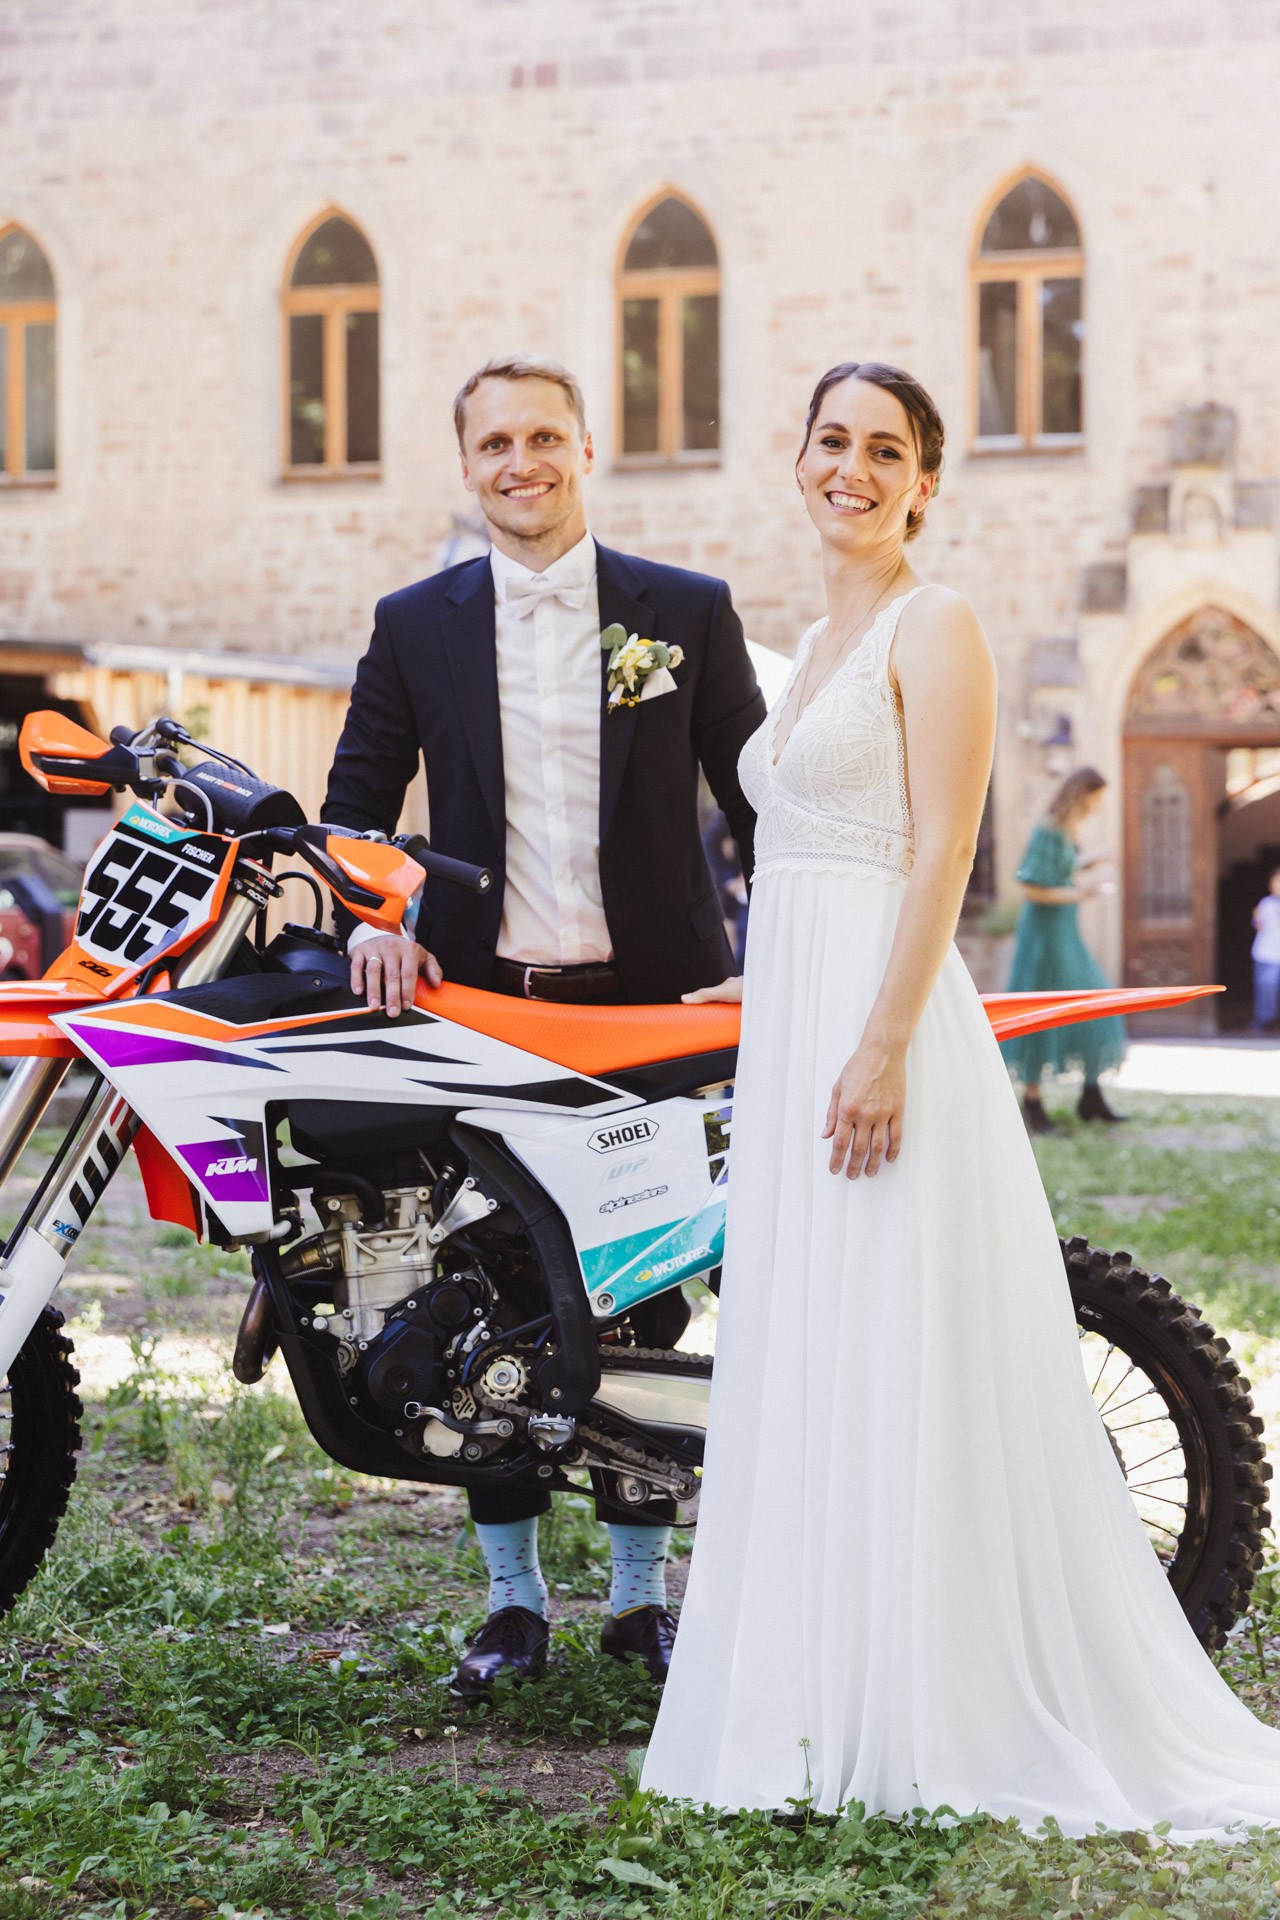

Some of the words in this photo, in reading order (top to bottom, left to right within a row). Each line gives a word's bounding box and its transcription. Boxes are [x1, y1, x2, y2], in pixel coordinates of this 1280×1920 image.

[181, 843, 216, 864] FISCHER
[77, 838, 215, 964] 555
[597, 1122, 651, 1149] SHOEI
[204, 1155, 258, 1177] KTM
[652, 1244, 715, 1278] MOTOREX
